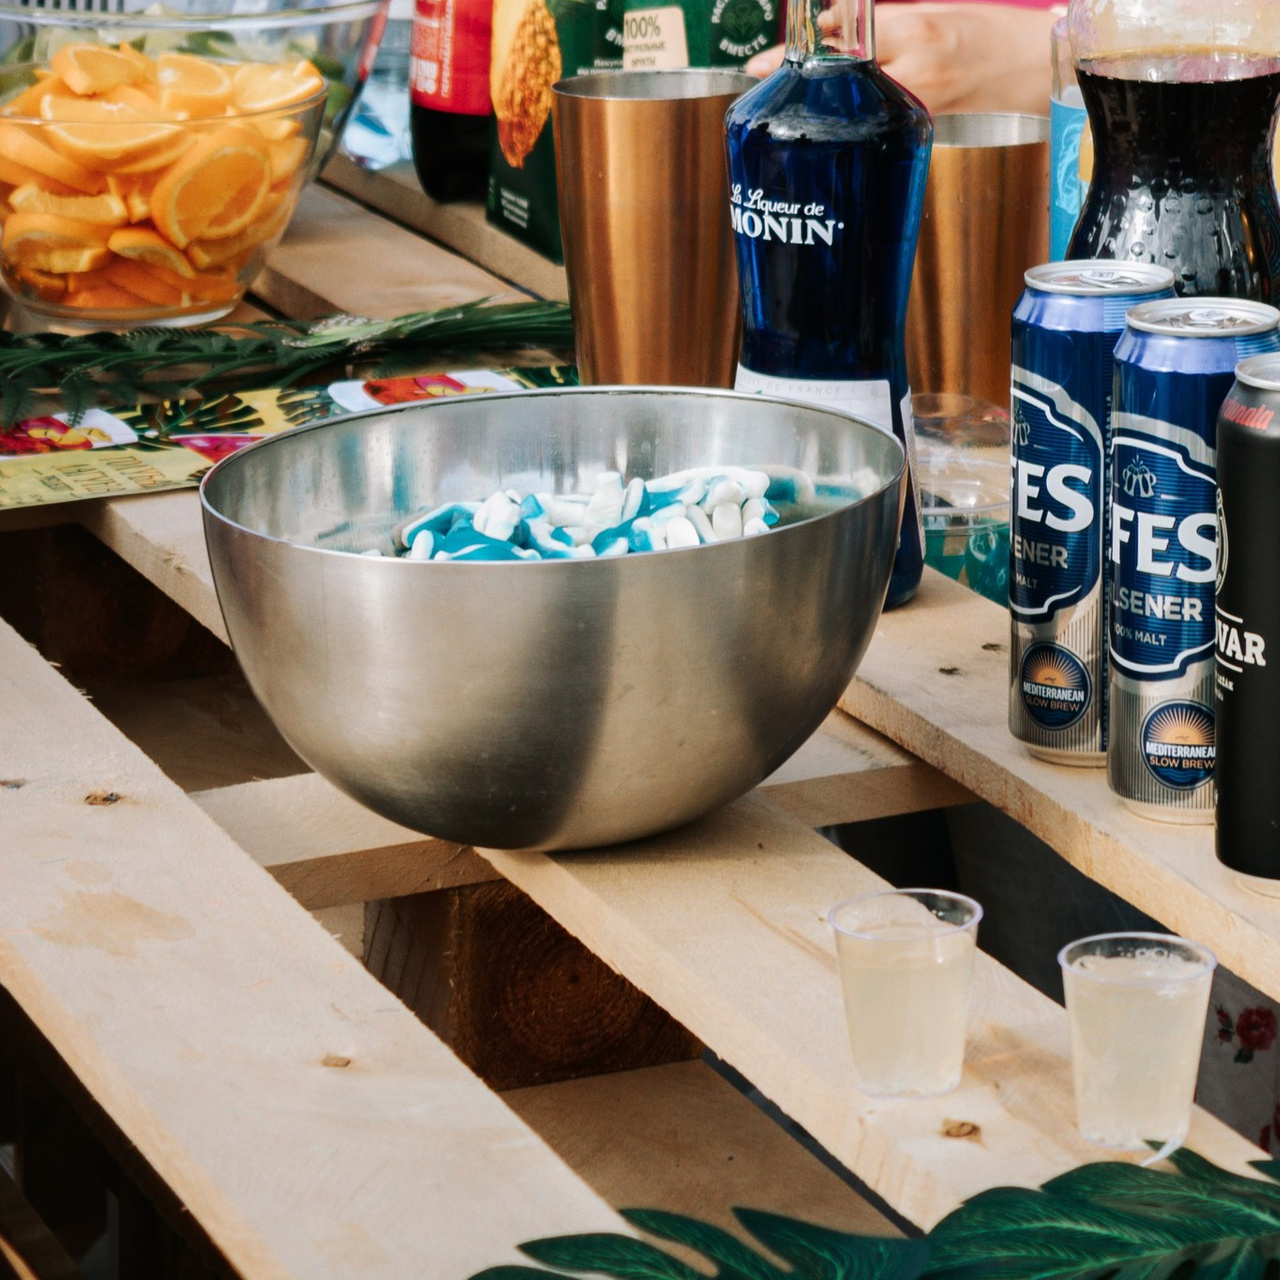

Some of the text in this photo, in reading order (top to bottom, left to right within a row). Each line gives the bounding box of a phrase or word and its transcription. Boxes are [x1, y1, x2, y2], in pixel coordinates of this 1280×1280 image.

[624, 14, 661, 39] 100%
[719, 34, 769, 57] ВМЕСТЕ
[743, 188, 801, 216] Liqueur
[803, 202, 825, 217] de
[730, 204, 836, 247] MONIN
[1109, 494, 1217, 584] FES
[1134, 630, 1168, 647] MALT
[1023, 680, 1085, 702] MEDITERRANEAN
[1025, 695, 1080, 712] SLOW BREW
[1149, 756, 1216, 769] SLOW BREW
